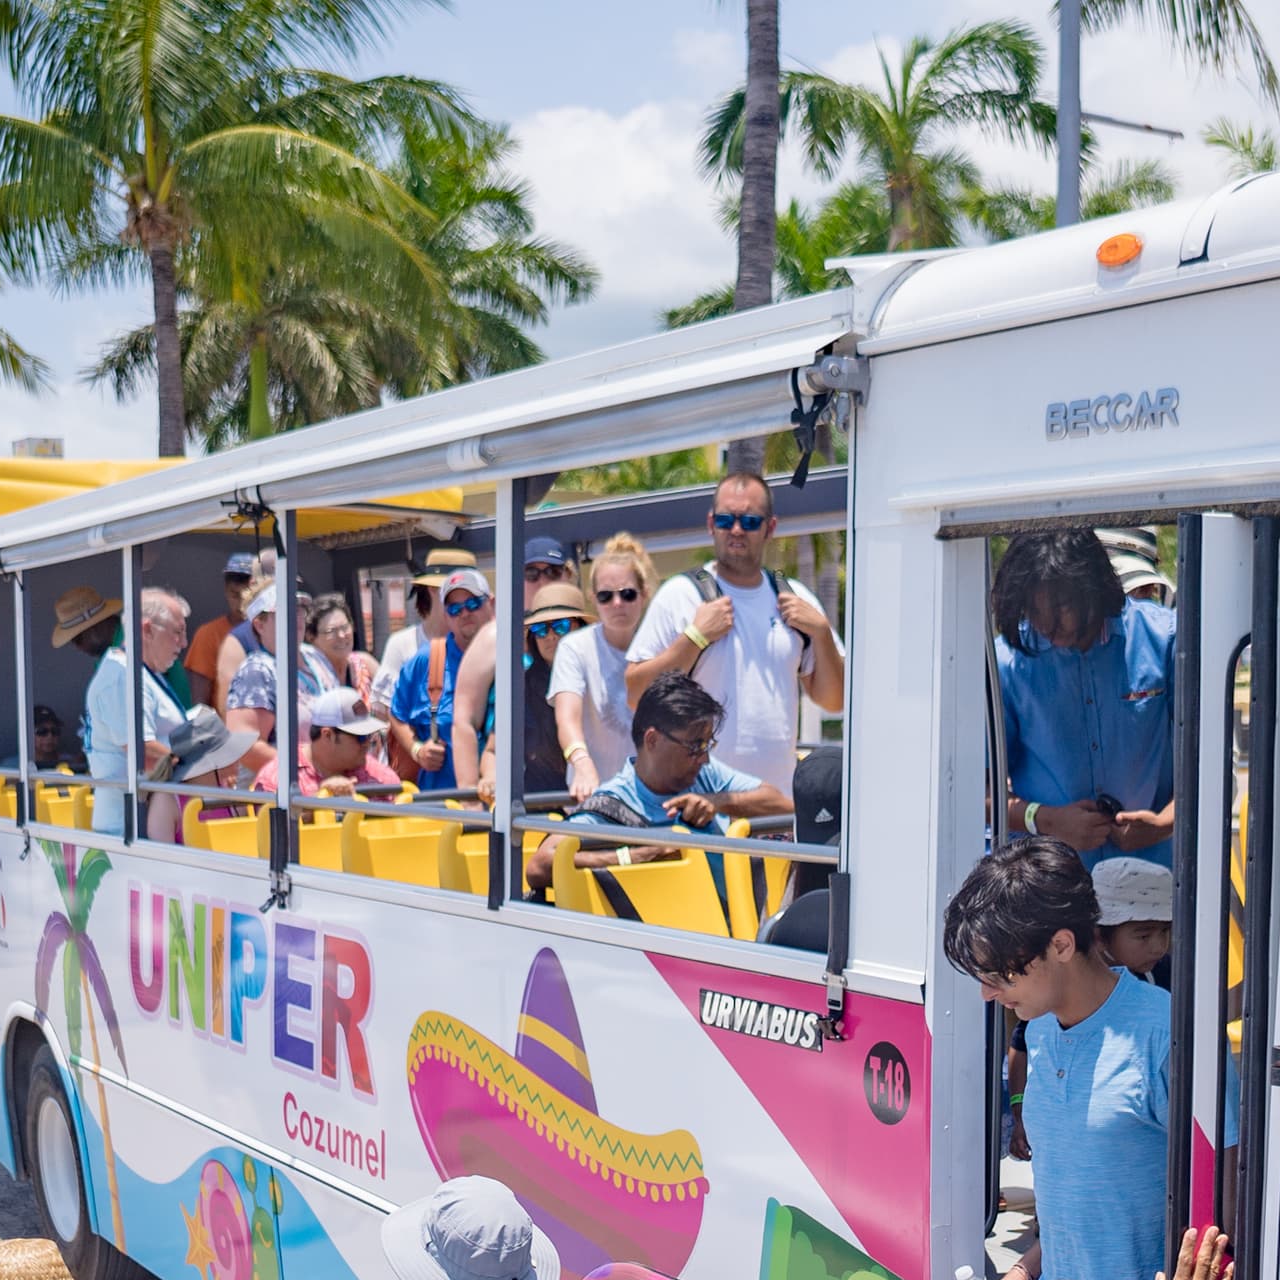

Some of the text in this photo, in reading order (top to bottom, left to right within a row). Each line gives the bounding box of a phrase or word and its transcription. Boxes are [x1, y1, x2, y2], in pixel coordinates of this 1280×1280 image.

[1045, 387, 1180, 442] BECCAR
[128, 883, 377, 1101] UNIPER
[702, 991, 818, 1049] URVIABUS
[870, 1056, 905, 1112] T-18
[283, 1091, 387, 1181] Cozumel
